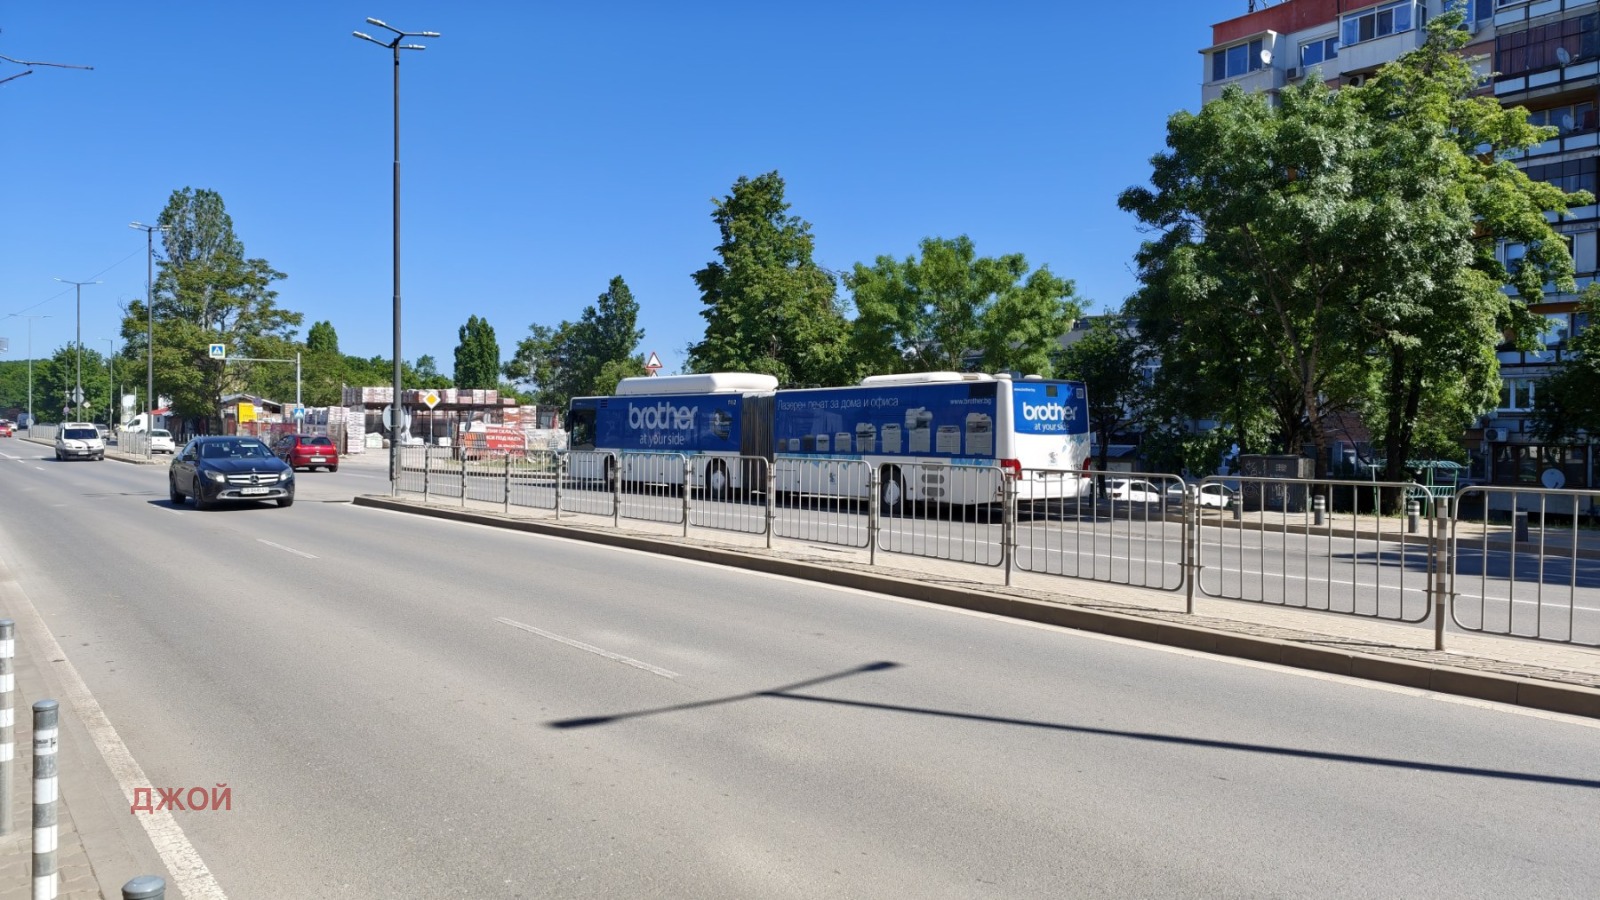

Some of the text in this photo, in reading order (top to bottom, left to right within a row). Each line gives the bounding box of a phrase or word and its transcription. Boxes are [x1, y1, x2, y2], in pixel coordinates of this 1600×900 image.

[777, 396, 899, 411] Лазерен печат за дома и офиса
[950, 398, 992, 406] www.brother.bg
[628, 401, 698, 430] brother
[1022, 402, 1078, 421] brother
[1034, 423, 1041, 431] at
[1042, 423, 1056, 432] your
[639, 433, 685, 448] at your side
